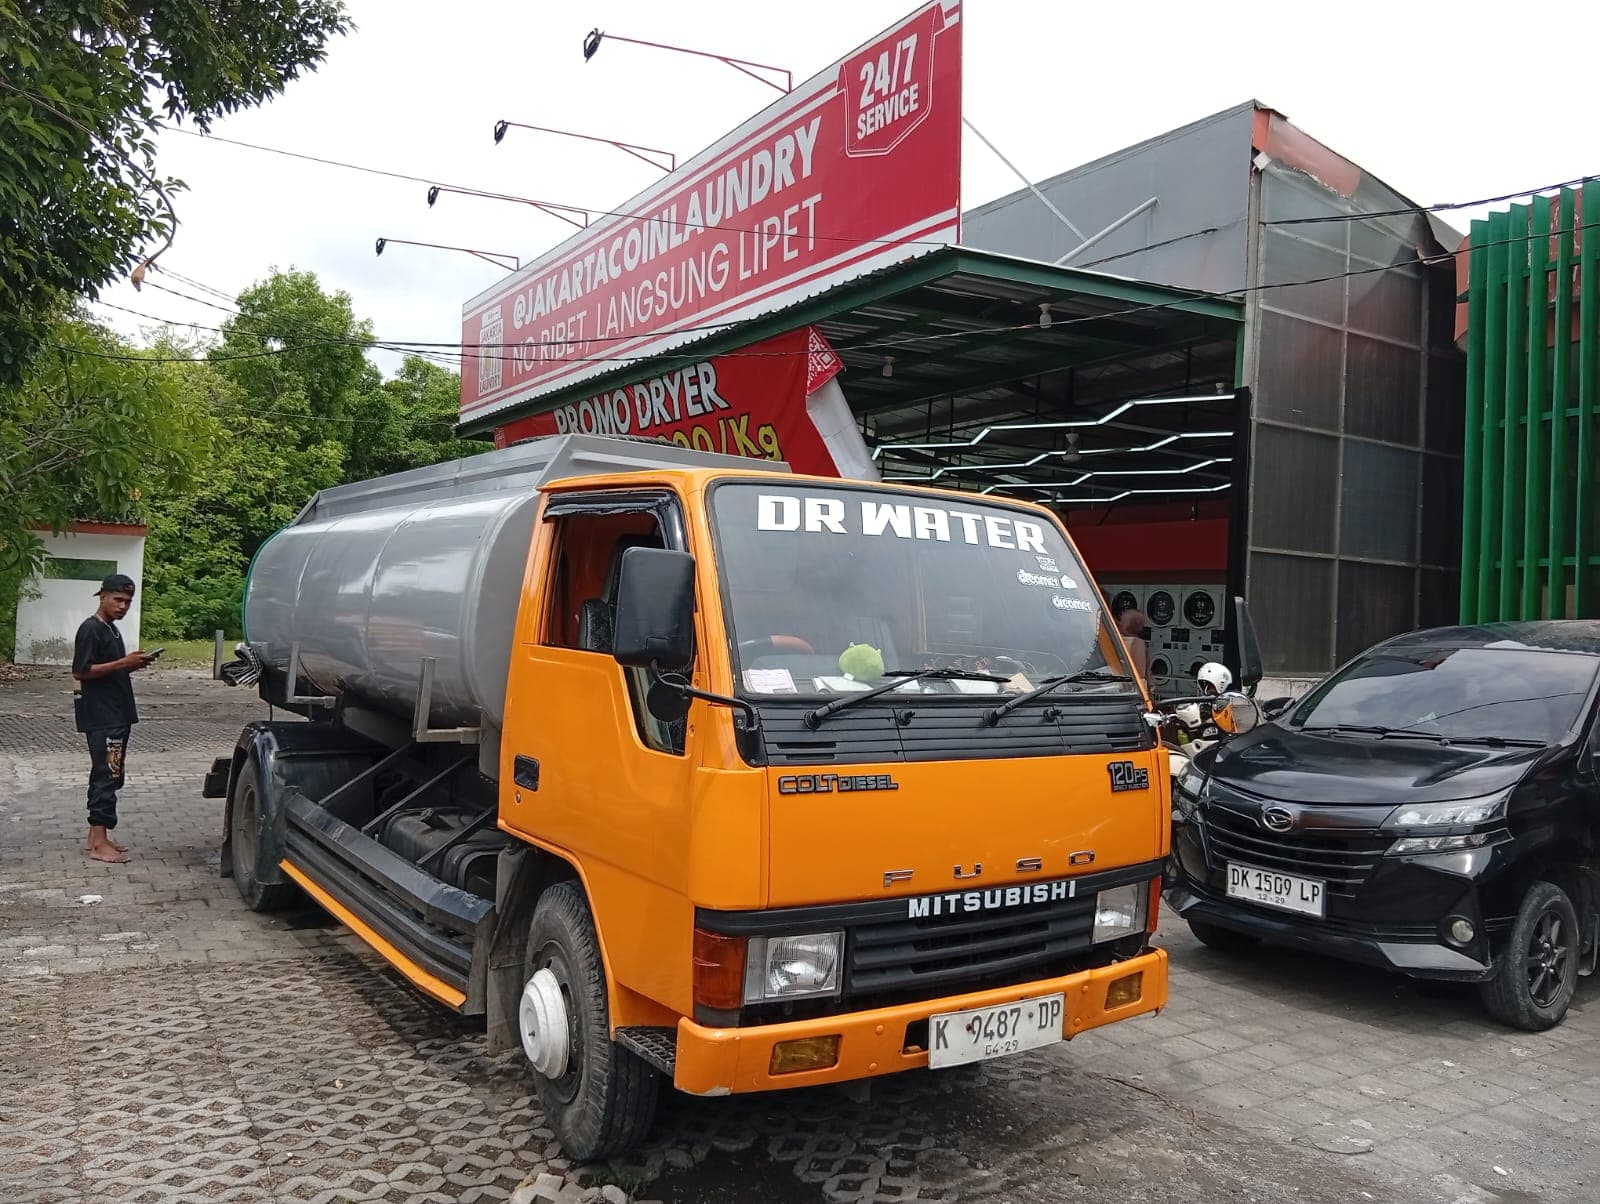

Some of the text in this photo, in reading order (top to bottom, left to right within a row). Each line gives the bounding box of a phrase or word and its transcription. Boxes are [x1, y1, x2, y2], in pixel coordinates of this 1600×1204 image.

[860, 33, 918, 110] 24/7
[857, 83, 919, 140] SERVICE
[513, 116, 822, 330] @JAKARTACOINLAUNDRY
[513, 336, 536, 377] NO
[540, 310, 588, 366] RIBET,
[597, 242, 730, 340] LANGSUNG
[739, 193, 823, 281] LIPET
[553, 362, 730, 435] PROMO DRYER
[757, 495, 1049, 554] DR WATER
[779, 773, 898, 794] COLT DIESEL
[883, 850, 1096, 887] FUSO
[1231, 867, 1320, 903] DK 1509 LP
[908, 880, 1077, 918] MITSUBISHI
[935, 999, 1061, 1050] K 9487 DP
